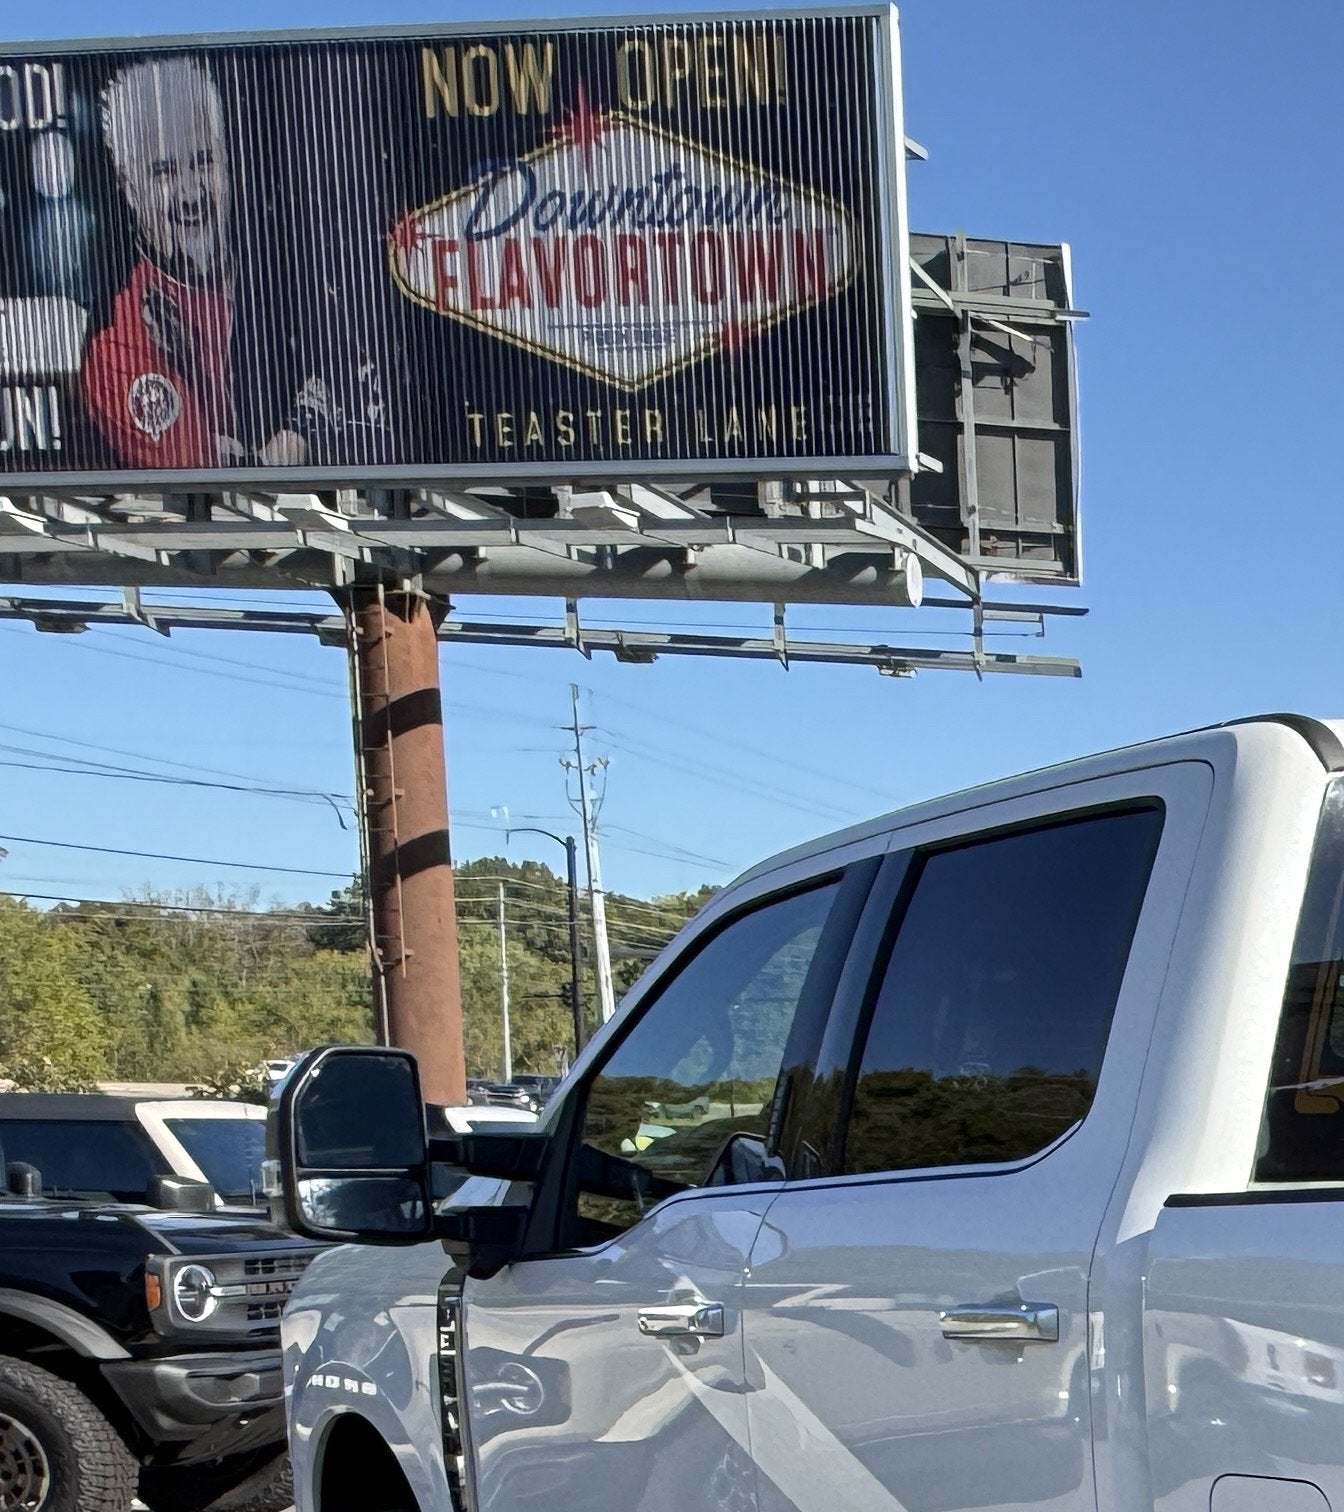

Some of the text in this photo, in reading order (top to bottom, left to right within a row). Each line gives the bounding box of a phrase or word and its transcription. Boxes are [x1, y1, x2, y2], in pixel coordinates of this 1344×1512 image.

[422, 35, 787, 118] NOW OPEN!
[465, 158, 791, 241] Downtown
[432, 228, 828, 311] FLAVORTOWN
[466, 404, 808, 447] TEASTER LANE
